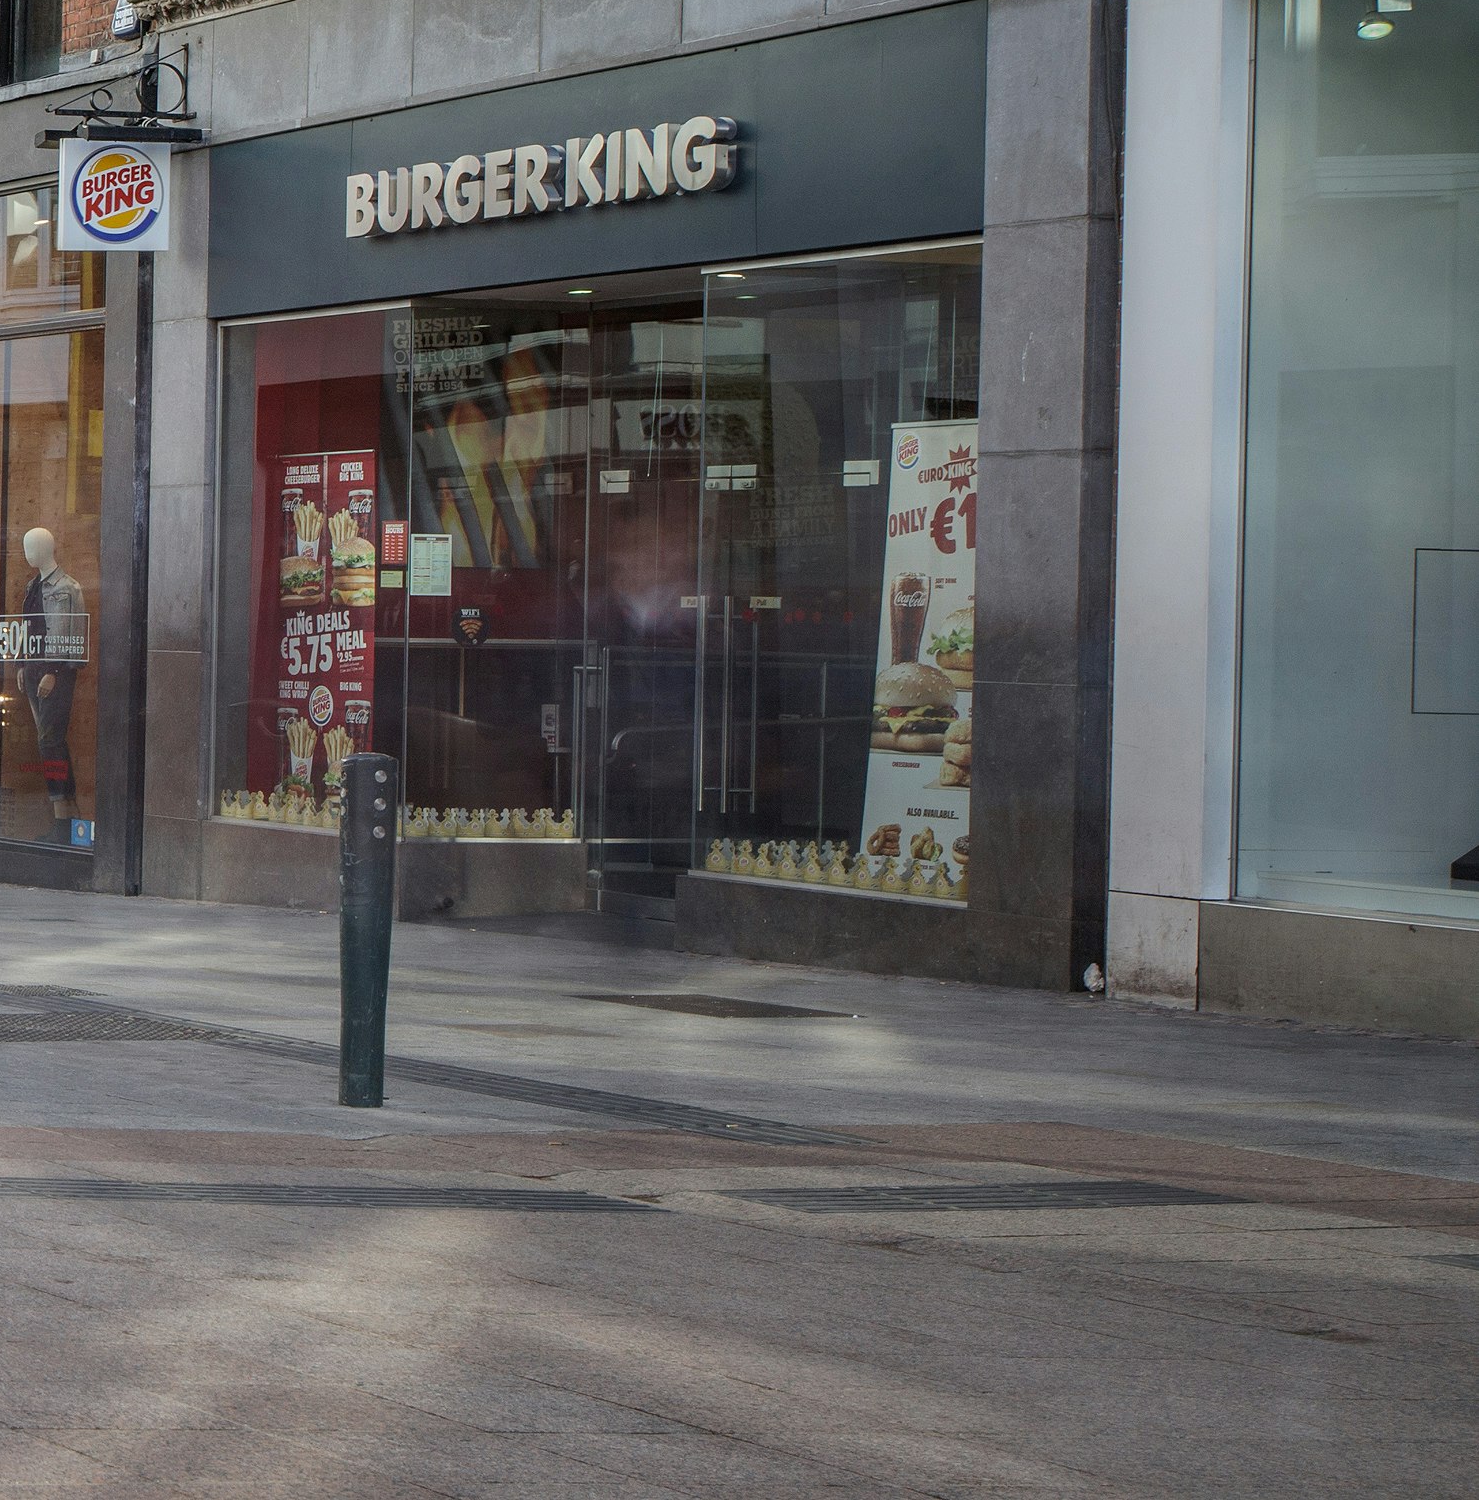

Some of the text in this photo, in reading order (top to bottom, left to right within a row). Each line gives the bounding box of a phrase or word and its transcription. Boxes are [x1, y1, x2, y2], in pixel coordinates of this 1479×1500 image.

[82, 164, 152, 199] BURGER
[346, 116, 738, 240] BURGER KING
[83, 182, 154, 225] KING
[393, 315, 483, 334] FRESHLY
[393, 330, 484, 349] GRILLED
[394, 346, 484, 364] OVER OPEN
[396, 361, 485, 383] FLAME
[396, 382, 435, 394] SINCE
[898, 438, 919, 453] BURGER
[898, 445, 919, 462] KING
[287, 464, 319, 475] LONG DELUXE
[340, 462, 363, 472] CHICKEN
[947, 462, 972, 480] KING
[285, 474, 320, 485] CHEESEBURGER
[339, 471, 364, 482] BIG KING
[889, 506, 928, 538] ONLY
[286, 610, 350, 637] KING DEALS
[45, 635, 84, 644] CUSTOMISED
[45, 645, 84, 655] AND TAPERED
[280, 629, 367, 676] €5.75 MEAL
[279, 681, 310, 690] SWEET CHILLI
[339, 682, 362, 692] BIG KING
[279, 690, 308, 699] KING WRAP
[312, 693, 331, 706] BURGER
[312, 701, 331, 716] KING
[906, 807, 922, 818] ALSO
